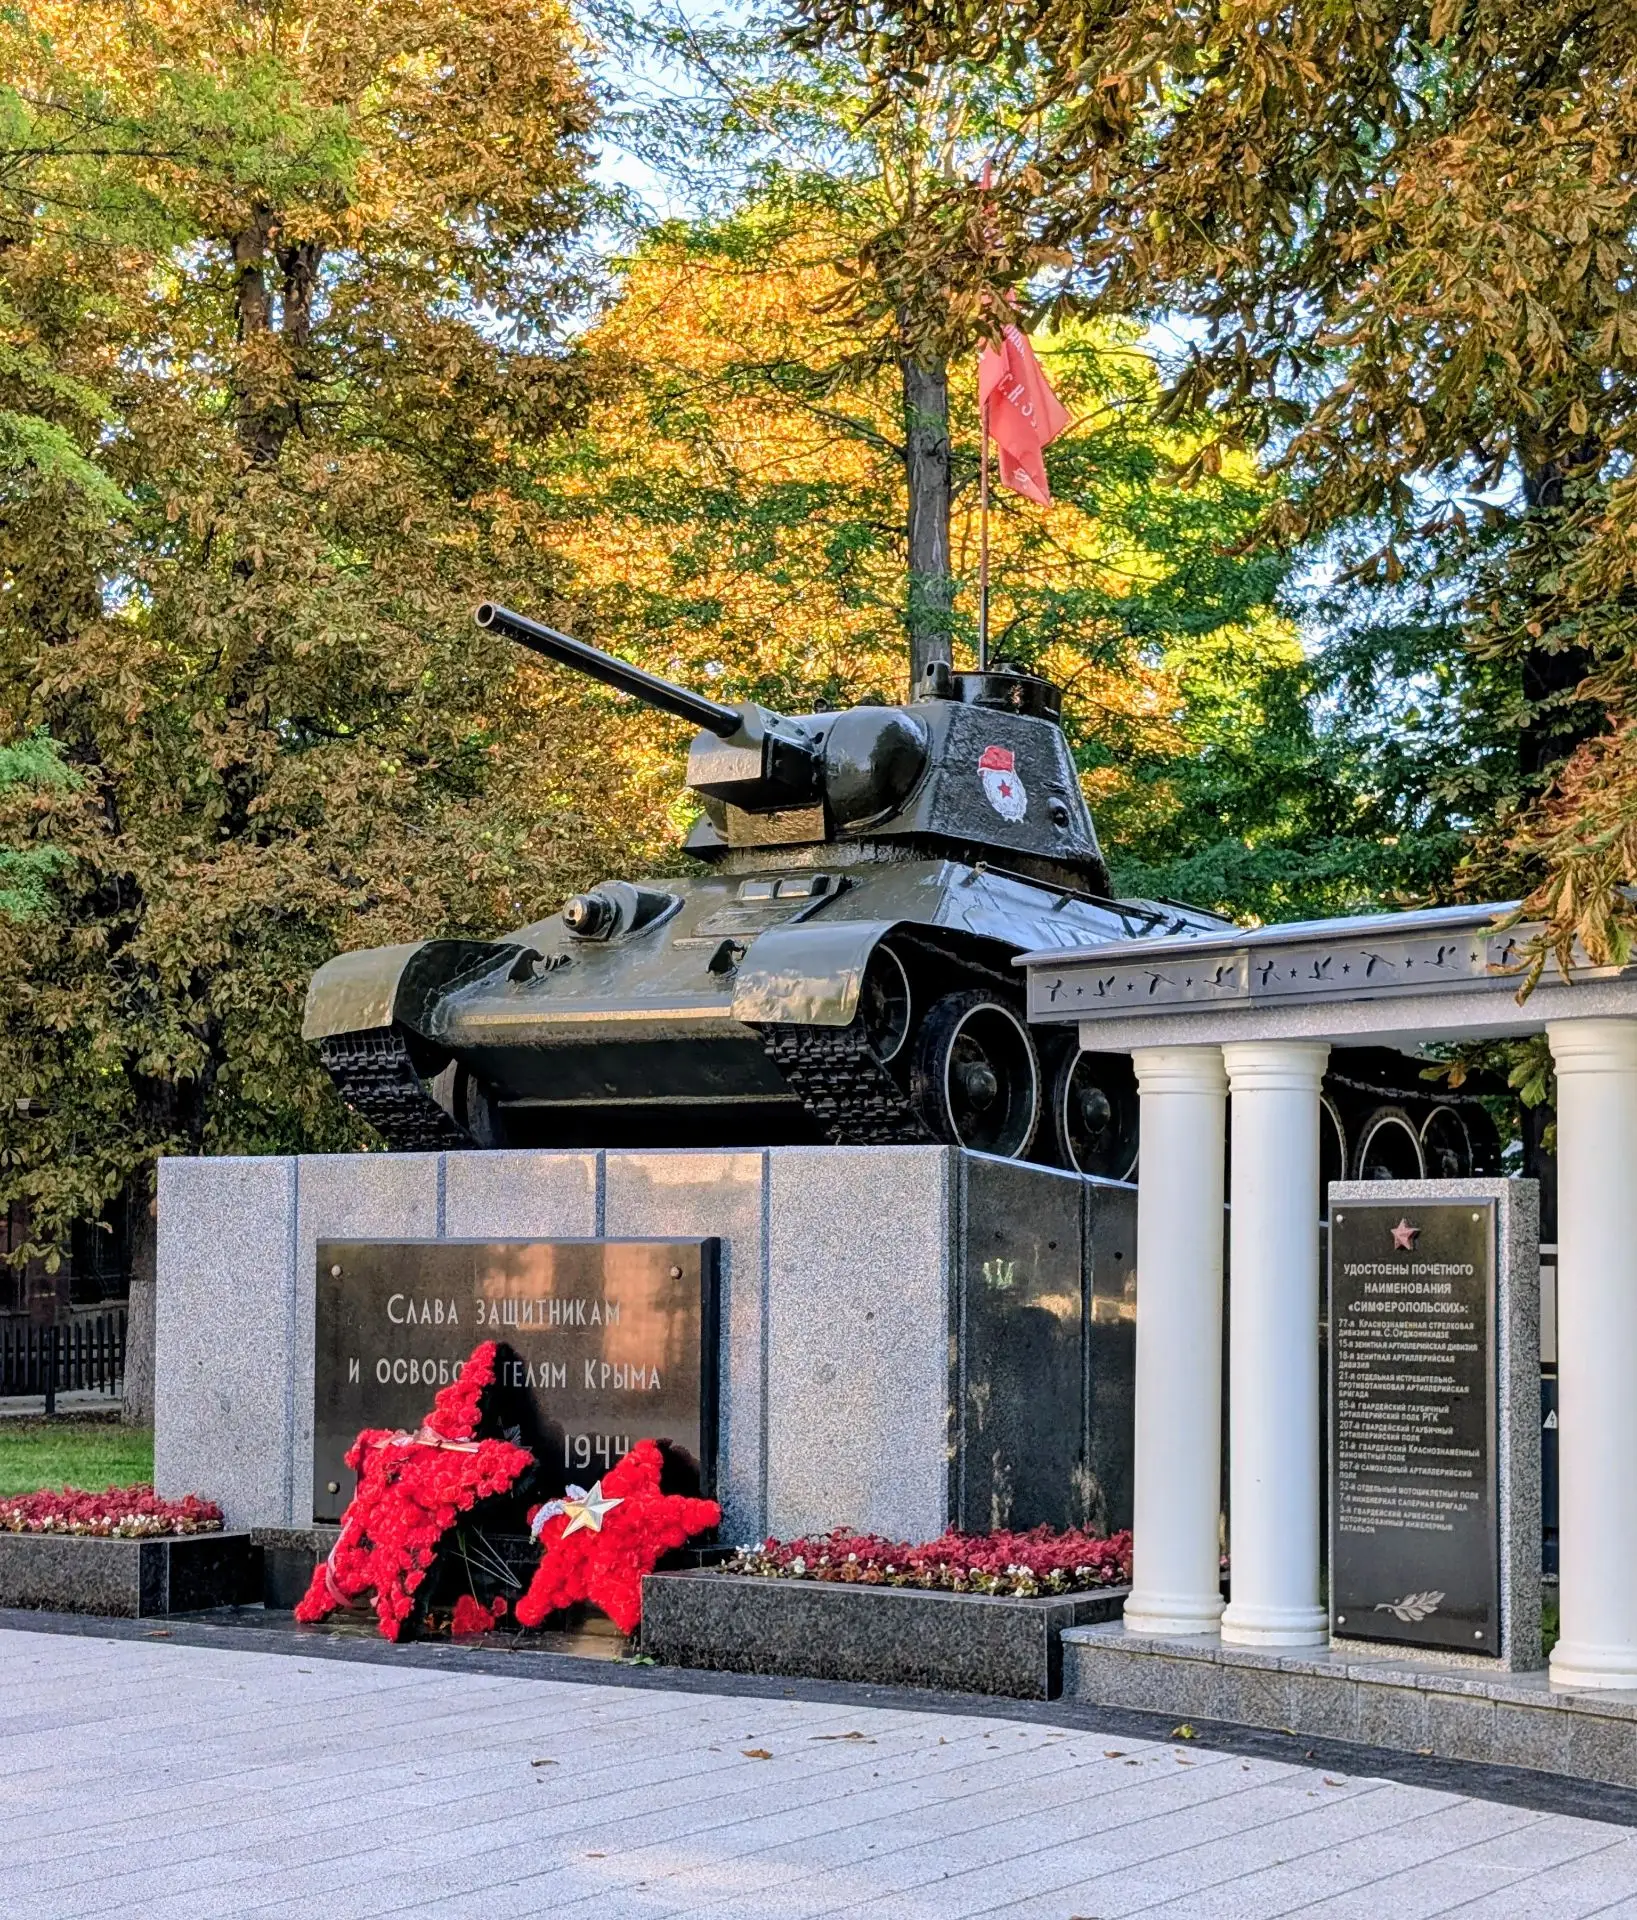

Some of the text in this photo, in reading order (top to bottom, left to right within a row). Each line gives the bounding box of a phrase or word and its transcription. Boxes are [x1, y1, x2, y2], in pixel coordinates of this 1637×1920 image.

[1344, 1264, 1409, 1276] УДОСТОЕНЫ
[1364, 1282, 1452, 1294] НАИМЕНОВАНИЯ
[387, 1294, 620, 1329] СЛАВА ЗАЩИТНИКАМ
[1348, 1301, 1468, 1314] «СИМФЕРОПОЛЬСКИХ»:
[1429, 1321, 1474, 1330] СТРЕЛКОВАЯ
[1338, 1329, 1370, 1337] ДИВИЗИЯ
[1355, 1341, 1387, 1349] ЗЕНИТНАЯ
[1388, 1342, 1446, 1350] АРТИЛЛЕРИЙСКАЯ
[1447, 1343, 1478, 1351] ДИВИЗИЯ
[1356, 1352, 1391, 1360] ЗЕНИТНАЯ
[1392, 1354, 1455, 1363] АРТИЛЛЕРИЙСКАЯ
[1338, 1361, 1370, 1369] ДИВИЗИЯ
[349, 1358, 661, 1389] И ОСВОБОТЕЛЯМ КРЫМА
[1356, 1373, 1394, 1381] ОТДЕЛЬНАЯ
[1338, 1390, 1369, 1398] БРИГАДА
[1406, 1384, 1470, 1393] АРТИЛЛЕРИЙСКАЯ
[1358, 1402, 1406, 1411] ГВАРДЕЙСКИЙ
[1408, 1404, 1449, 1413] ГАУБИЧНЫЙ
[1339, 1411, 1439, 1422] АРТИЛЛЕРИЙСКИЙ ПОЛК РГК
[564, 1434, 629, 1469] 1944
